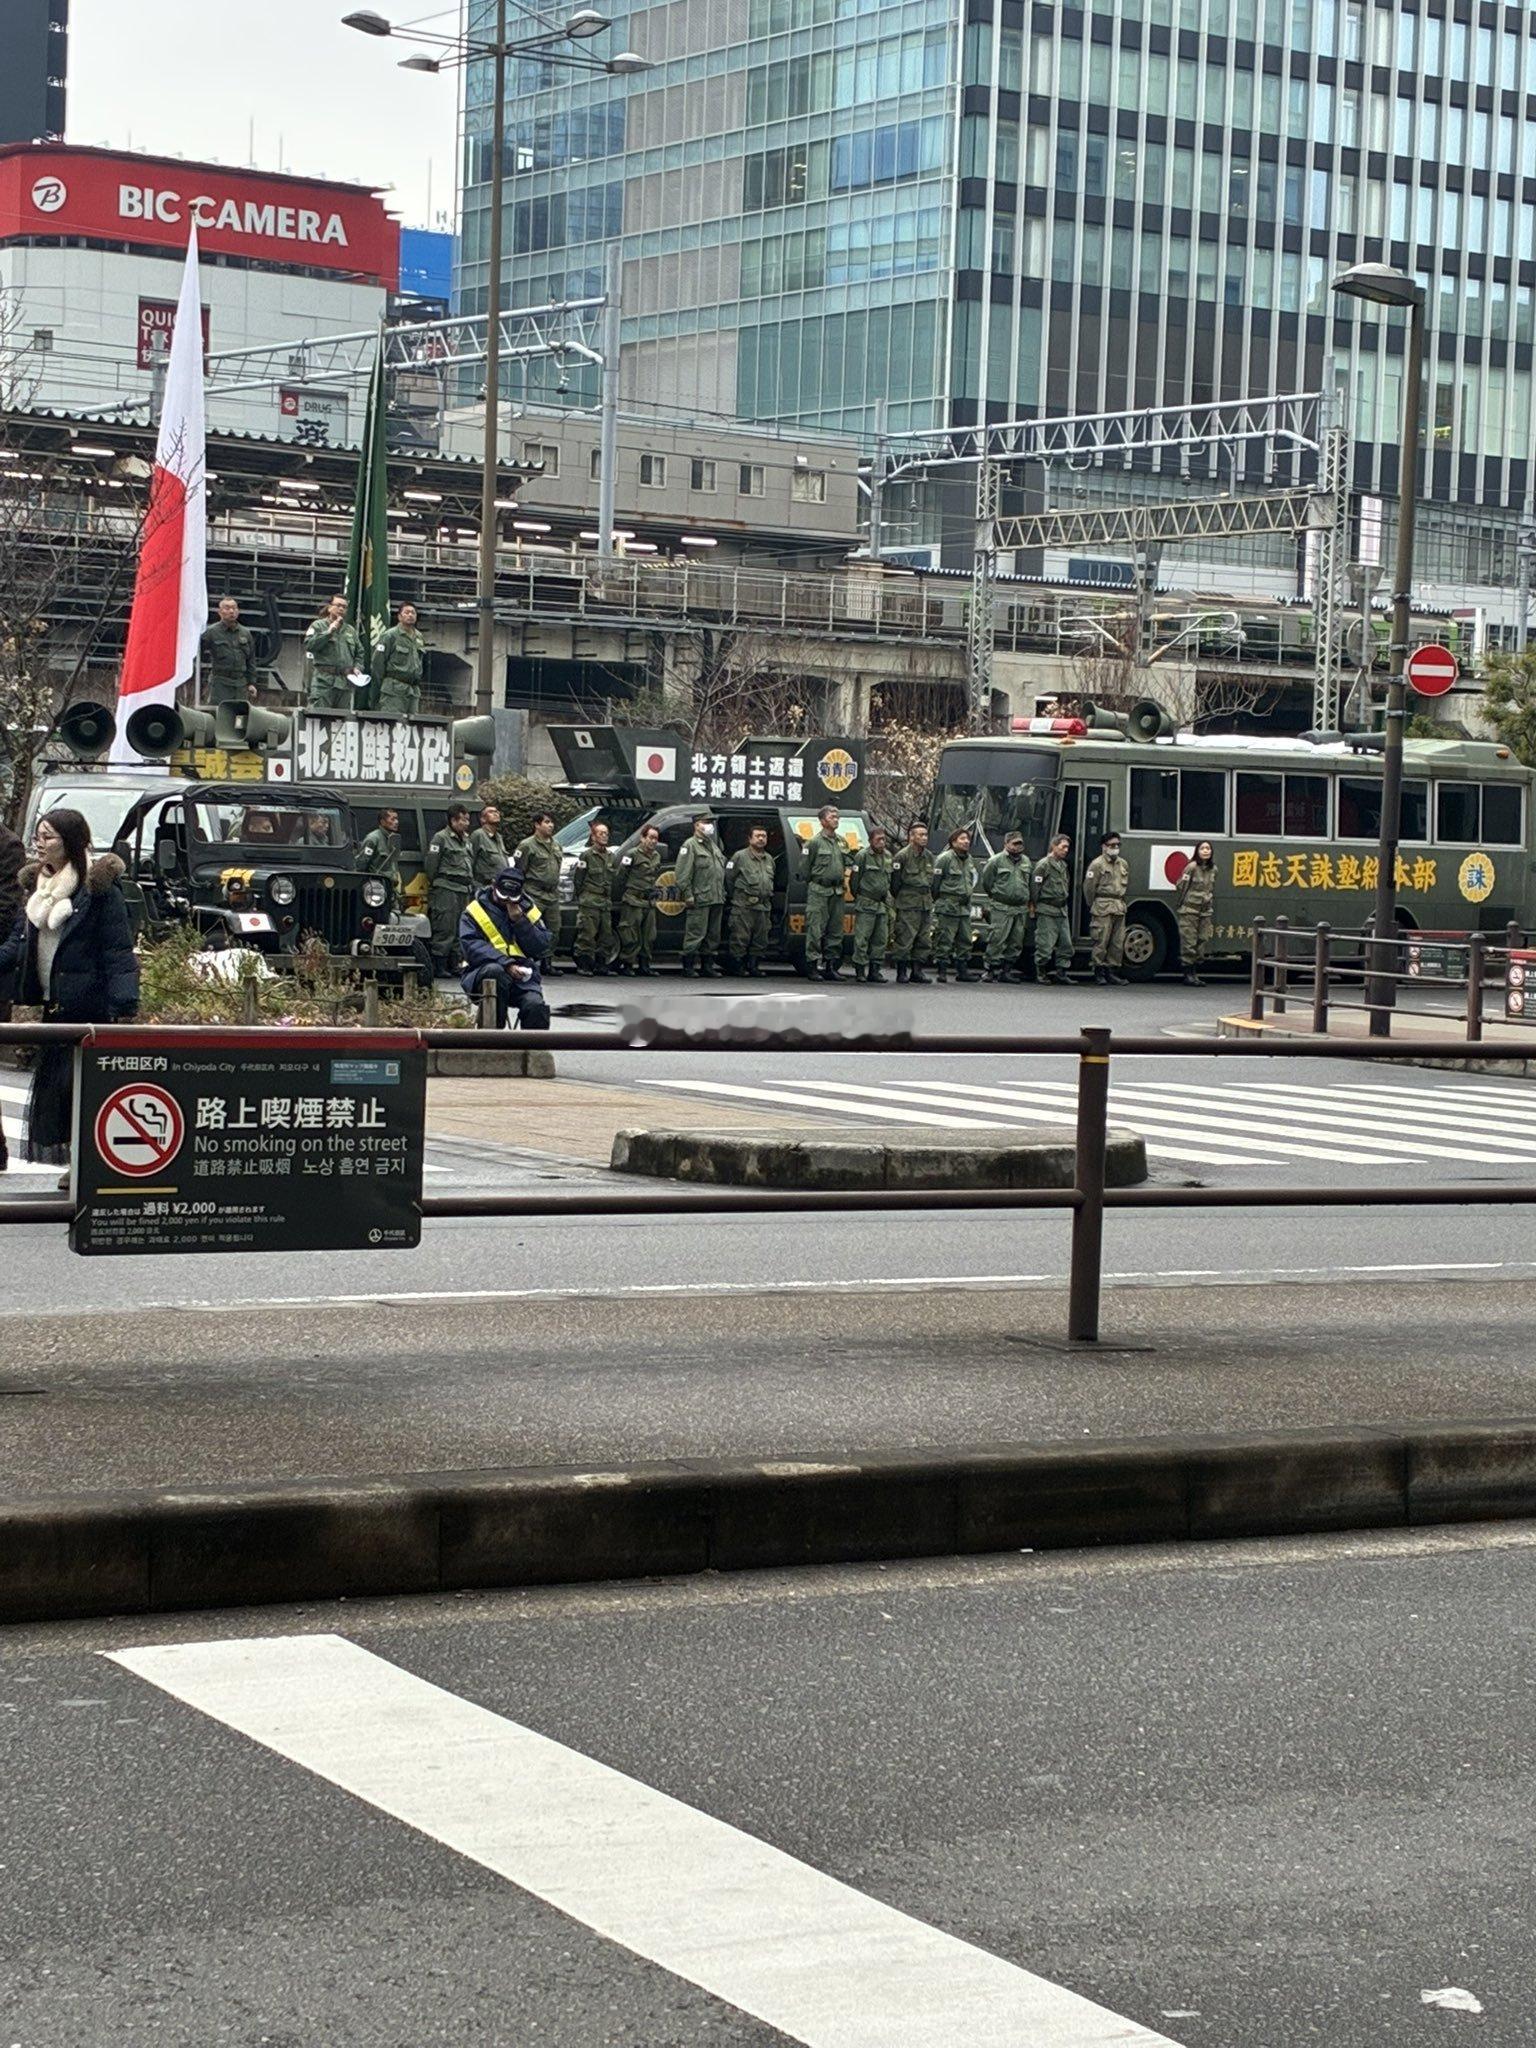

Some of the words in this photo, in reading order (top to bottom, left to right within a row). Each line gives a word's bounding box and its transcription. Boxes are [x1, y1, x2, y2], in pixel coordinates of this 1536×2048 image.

[119, 184, 182, 223] BIC
[194, 195, 349, 247] CAMERA
[304, 401, 333, 414] DRUG
[298, 717, 451, 785] 北朝鮮粉砕
[691, 752, 804, 778] 北方領土返還
[690, 777, 803, 801] 失地領土回復
[97, 1055, 168, 1071] 千代田区内
[183, 1062, 217, 1073] Chiyoda
[219, 1062, 236, 1073] City
[195, 1096, 387, 1130] 路上喫煙禁止
[193, 1135, 219, 1152] No
[223, 1133, 297, 1157] smoking
[301, 1138, 323, 1151] on
[327, 1134, 355, 1152] the
[359, 1135, 409, 1151] street
[193, 1158, 292, 1177] 道路禁止吸烟
[302, 1157, 335, 1176] 노상
[338, 1157, 370, 1175] 흡연
[374, 1157, 406, 1175] 금지
[143, 1201, 170, 1216] 過料
[172, 1201, 217, 1215] ¥2,000
[91, 1218, 108, 1226] You
[126, 1217, 138, 1226] be
[139, 1216, 160, 1225] fined
[208, 1217, 224, 1226] you
[269, 1214, 286, 1223] rule
